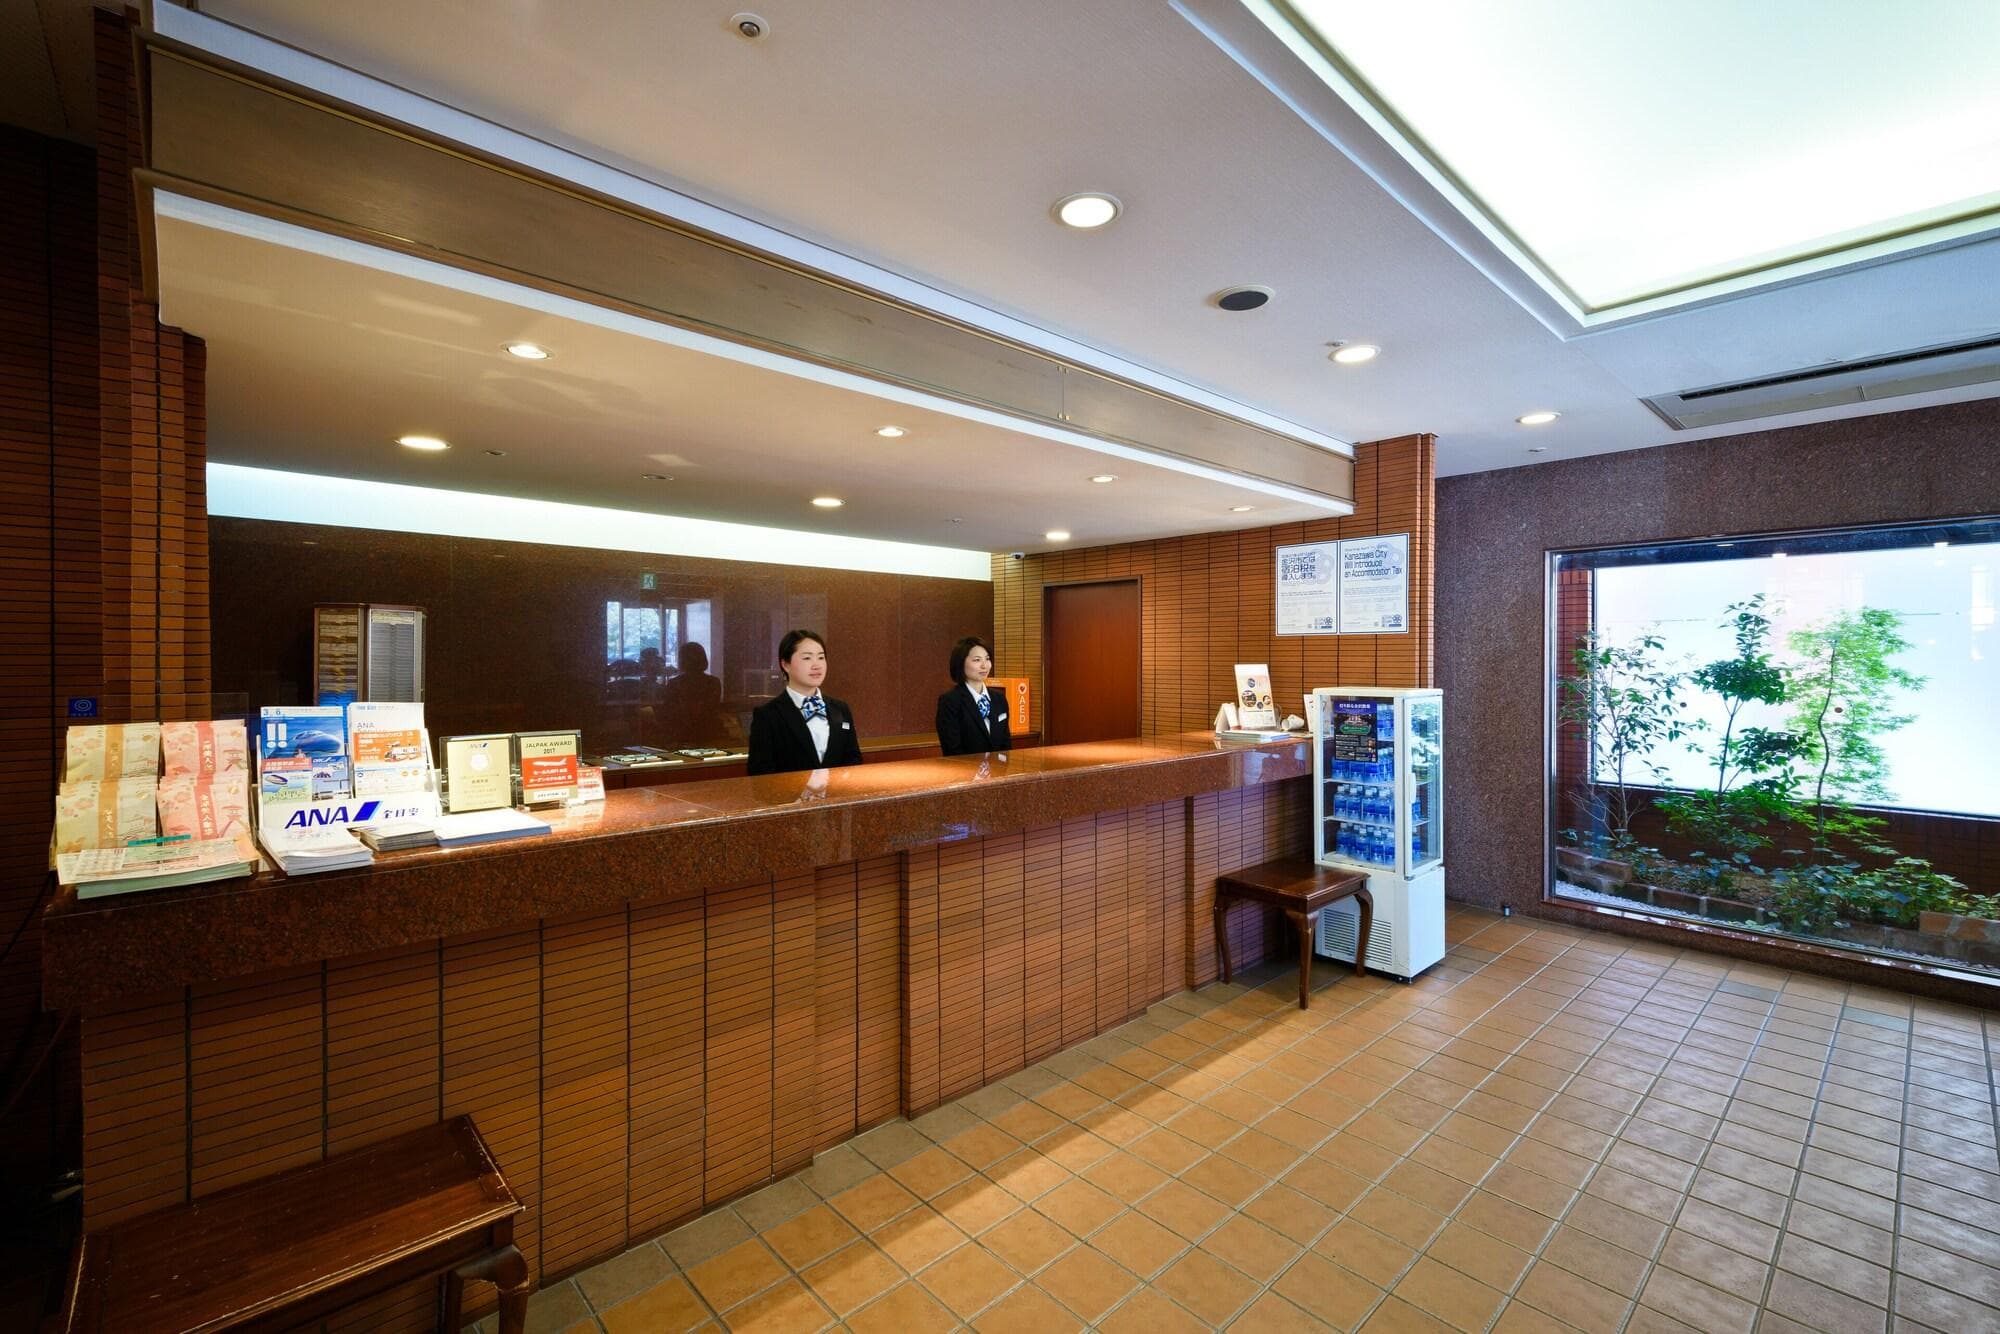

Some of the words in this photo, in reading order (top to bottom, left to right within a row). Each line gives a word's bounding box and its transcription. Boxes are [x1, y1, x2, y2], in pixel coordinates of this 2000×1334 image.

[1345, 552, 1374, 560] Kanazawa
[1375, 549, 1387, 558] City
[1392, 566, 1402, 575] Tax
[543, 747, 556, 755] 2017
[285, 806, 349, 829] ANA
[383, 807, 419, 819] 全日空
